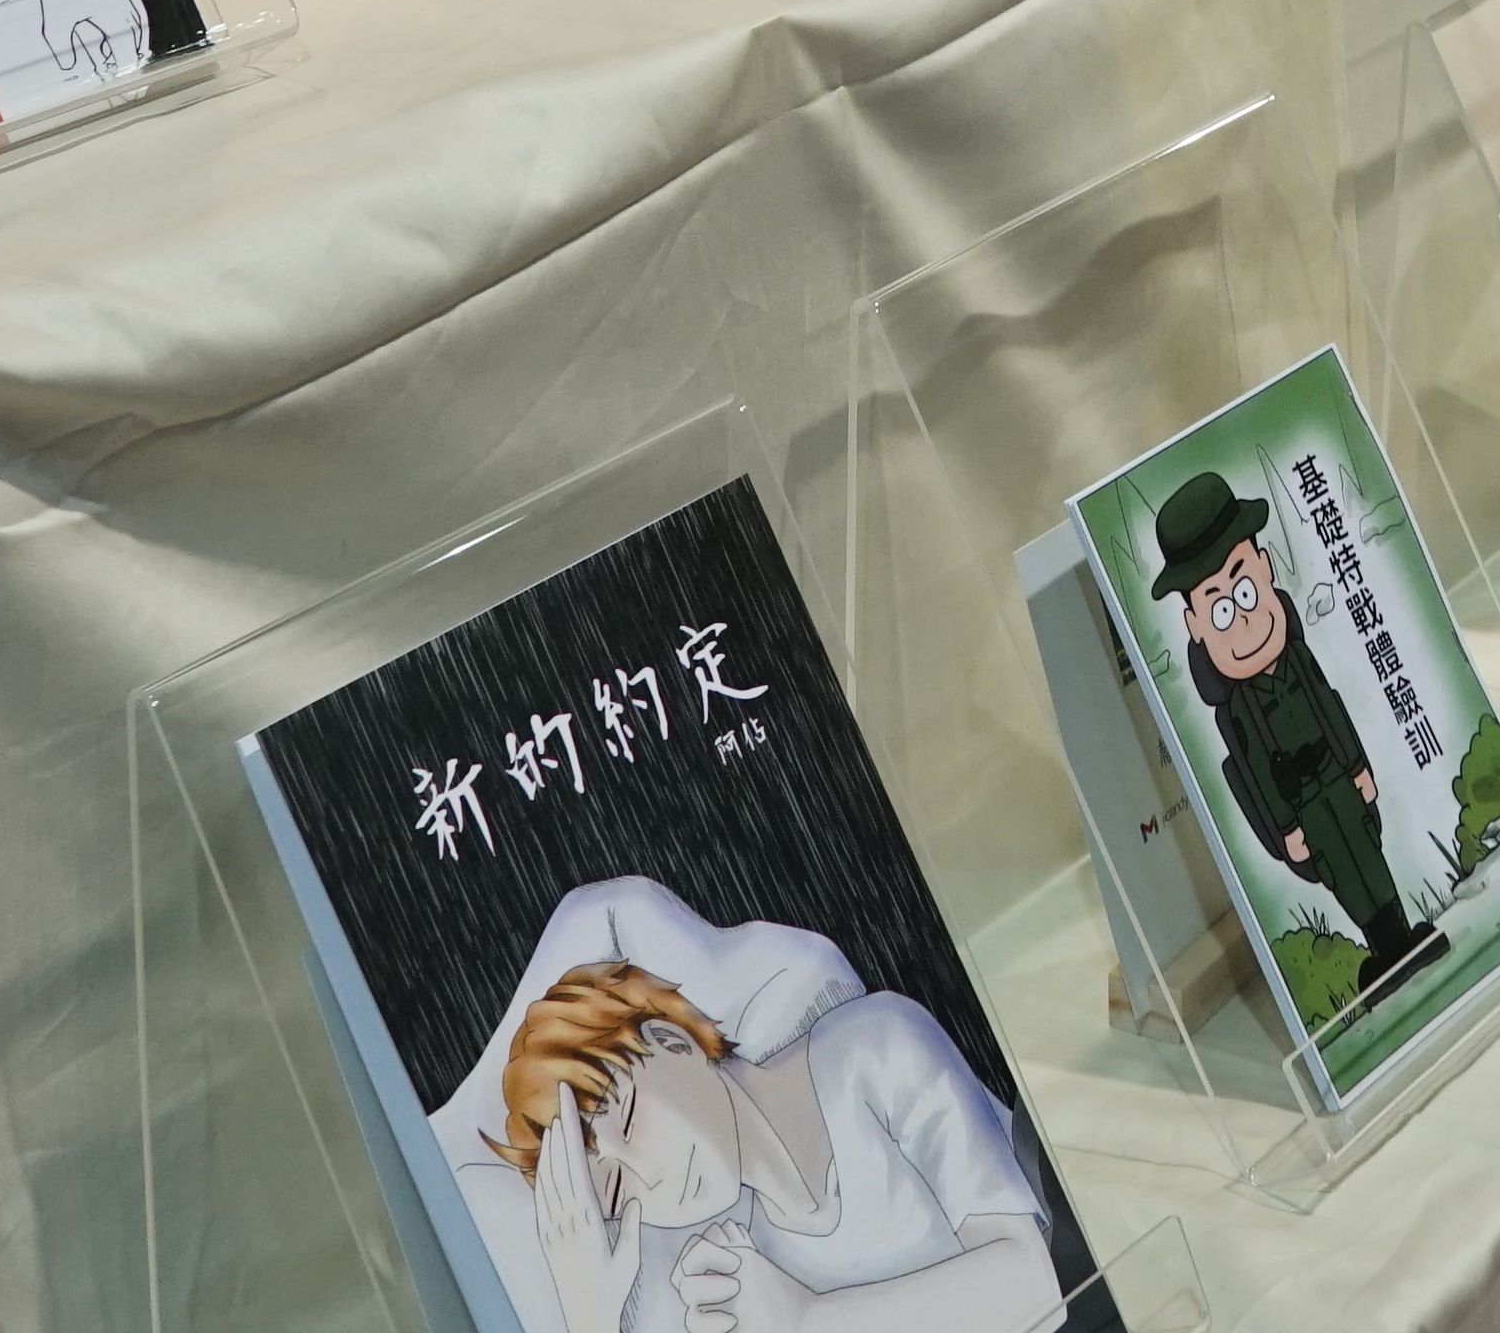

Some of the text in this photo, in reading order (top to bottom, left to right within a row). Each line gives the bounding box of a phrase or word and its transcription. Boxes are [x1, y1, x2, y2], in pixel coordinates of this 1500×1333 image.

[411, 621, 770, 862] 新的約定
[1291, 452, 1445, 771] 基礎特戰體驗訓
